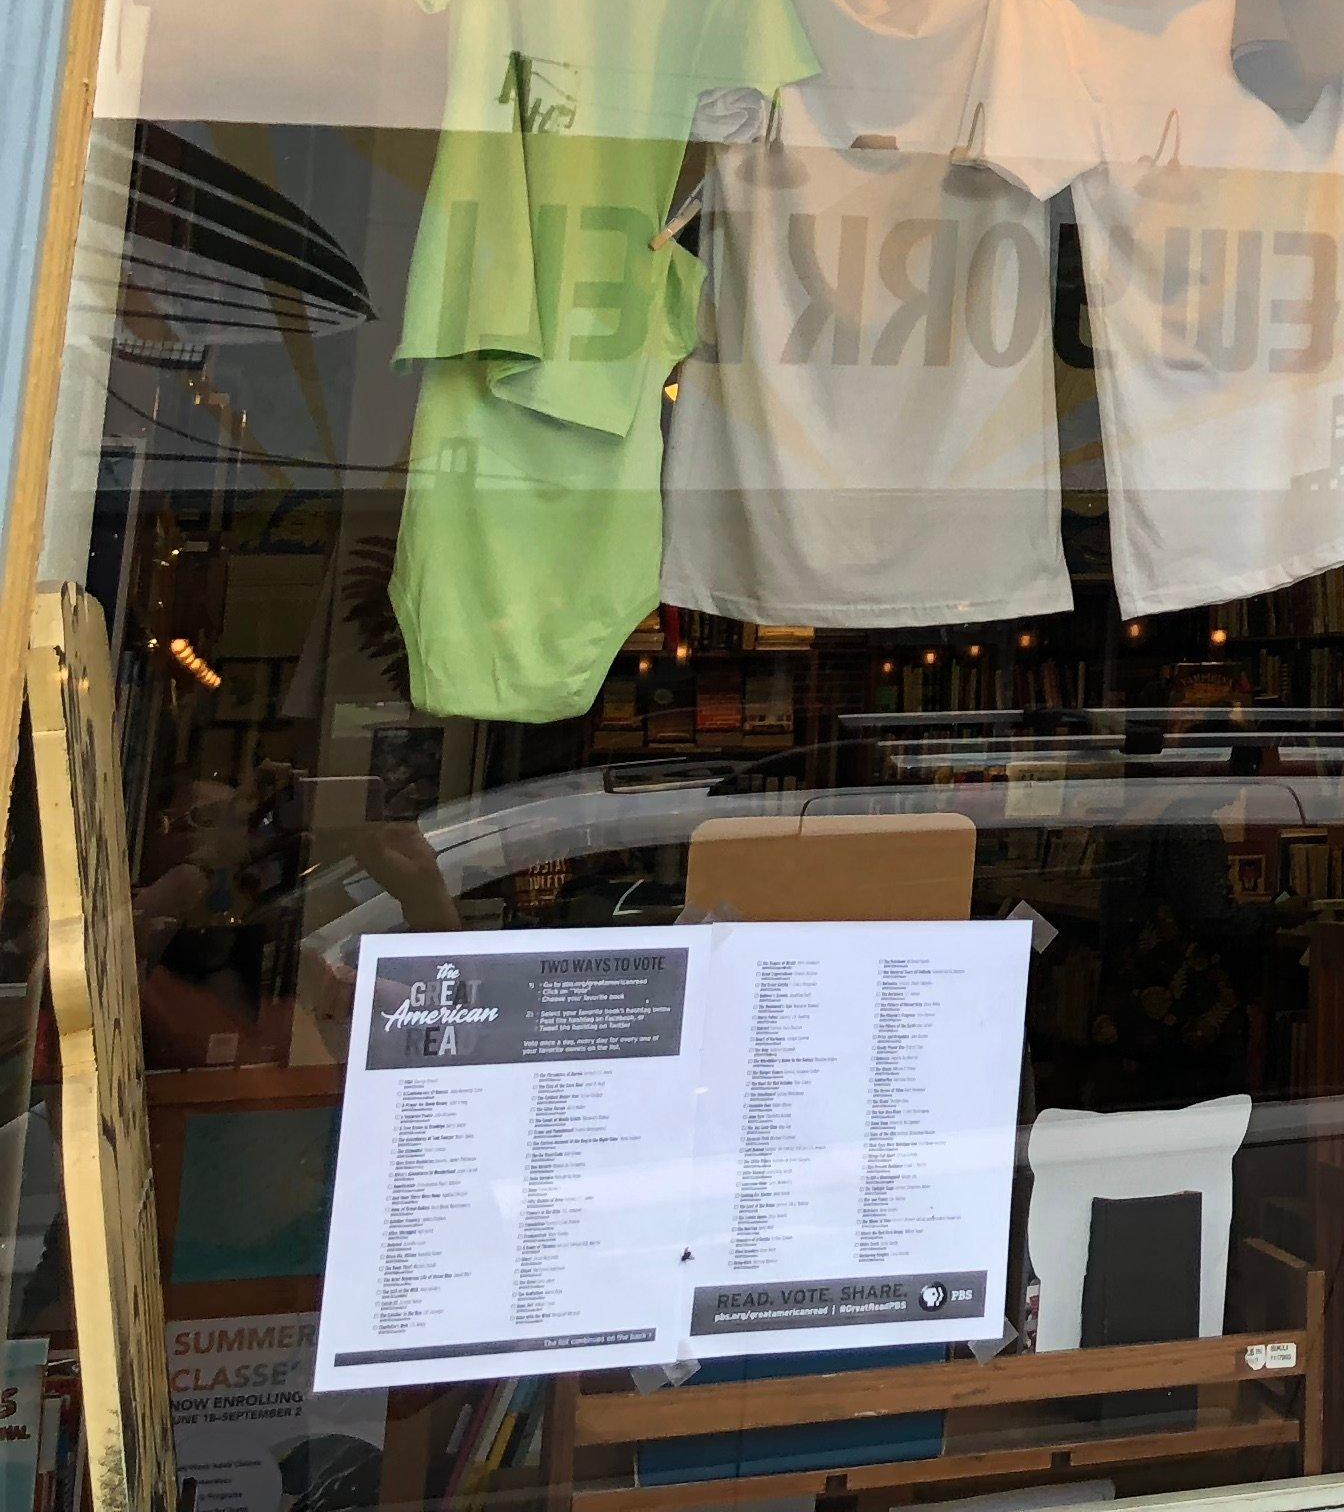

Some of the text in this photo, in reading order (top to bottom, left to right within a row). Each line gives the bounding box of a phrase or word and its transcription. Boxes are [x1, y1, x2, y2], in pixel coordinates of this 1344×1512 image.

[436, 963, 460, 980] the
[540, 956, 666, 974] TWO WAYS TO VOTE
[381, 998, 500, 1032] American
[717, 1283, 974, 1310] READ. VOTE. SHARE. PBS
[174, 1323, 318, 1356] SUMMER
[170, 1391, 303, 1412] NOW ENROLLING
[173, 1413, 198, 1426] UNE
